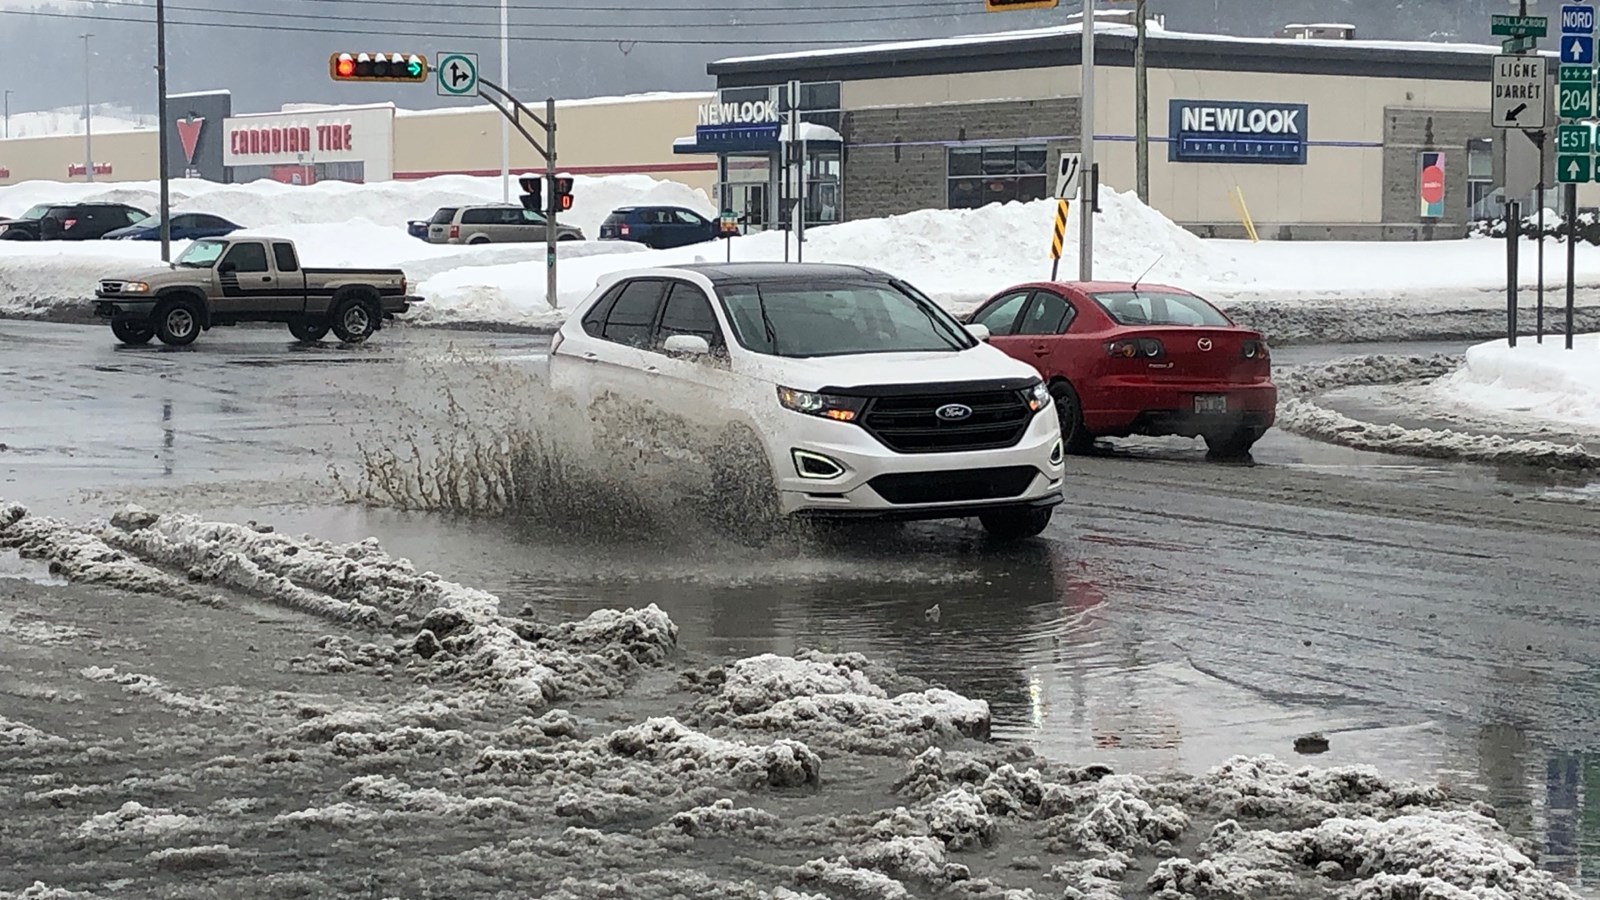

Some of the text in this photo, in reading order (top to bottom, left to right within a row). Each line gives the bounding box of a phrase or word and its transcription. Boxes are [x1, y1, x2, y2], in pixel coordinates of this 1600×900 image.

[1563, 12, 1592, 28] NORD
[1501, 63, 1537, 78] LIGNE
[1496, 82, 1540, 99] D'ARRÊT
[1561, 89, 1590, 111] 204
[698, 100, 778, 125] NEWLOOK
[1181, 107, 1299, 133] NEWLOOK
[231, 123, 352, 154] CANADIAN TIRE
[1561, 131, 1588, 148] EST
[944, 407, 965, 417] Ford
